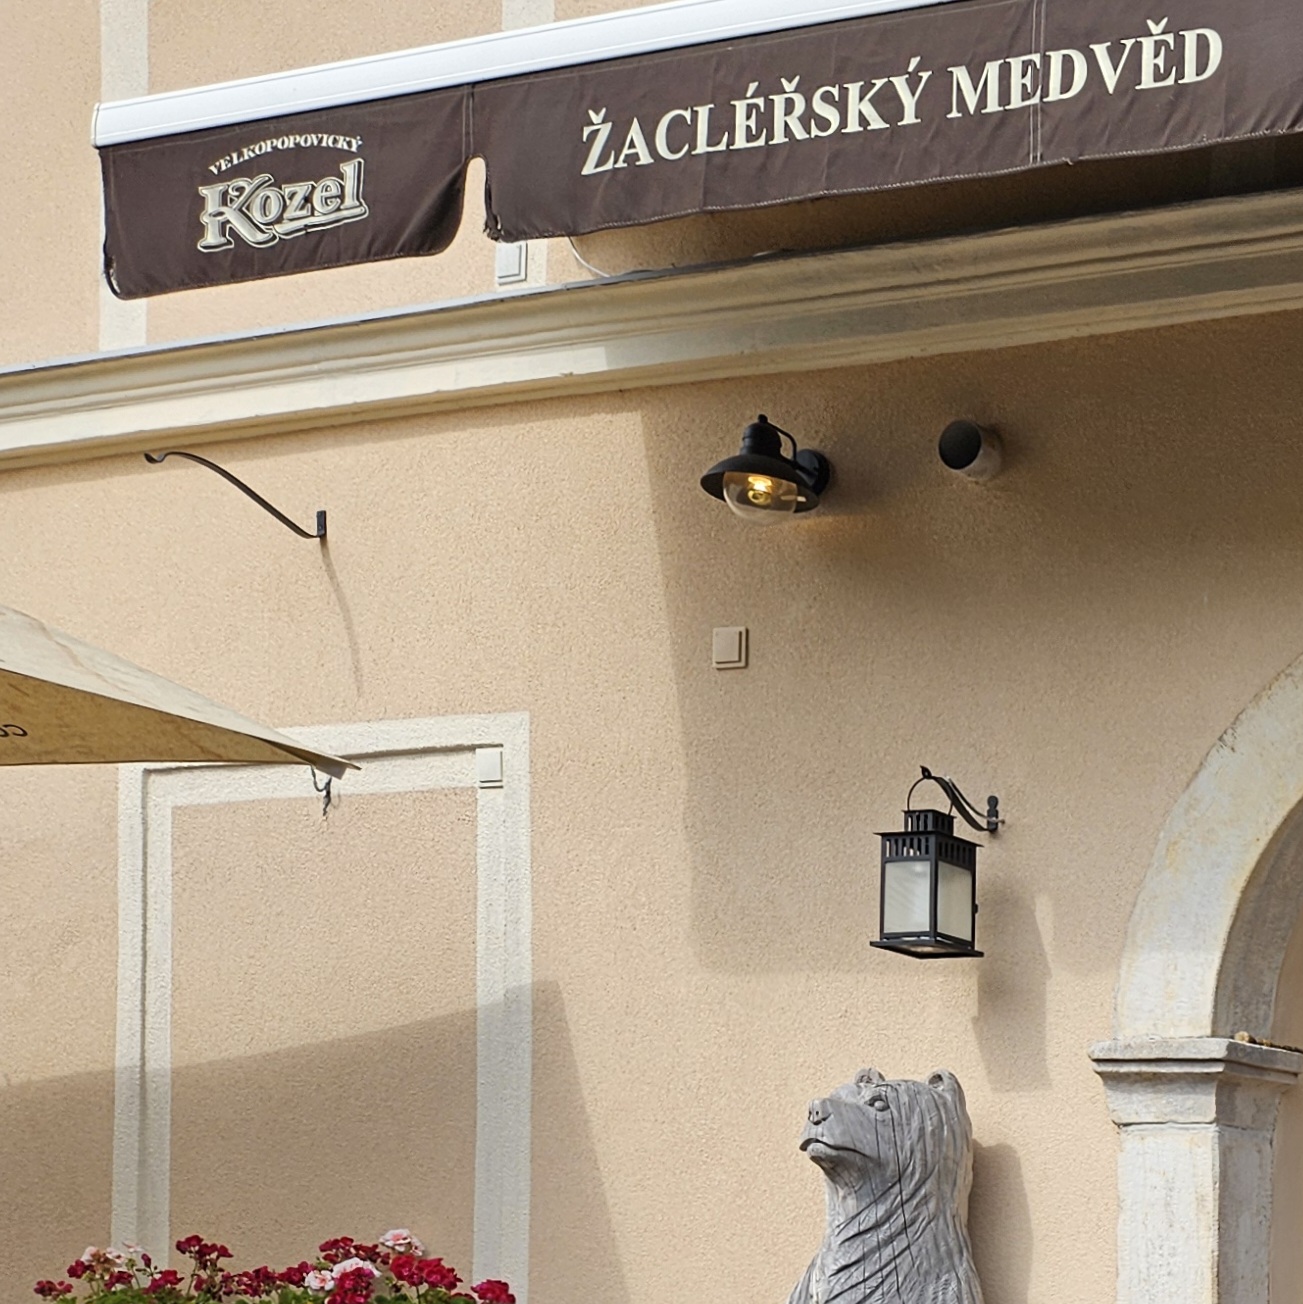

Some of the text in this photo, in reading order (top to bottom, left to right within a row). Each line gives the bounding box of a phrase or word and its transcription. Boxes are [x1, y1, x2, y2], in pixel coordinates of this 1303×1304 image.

[580, 17, 1224, 176] ŽACLÉŘSKÝ MEDVĚD
[208, 133, 363, 175] VELKOPOPOVICKÝ
[197, 158, 369, 253] Kozel
